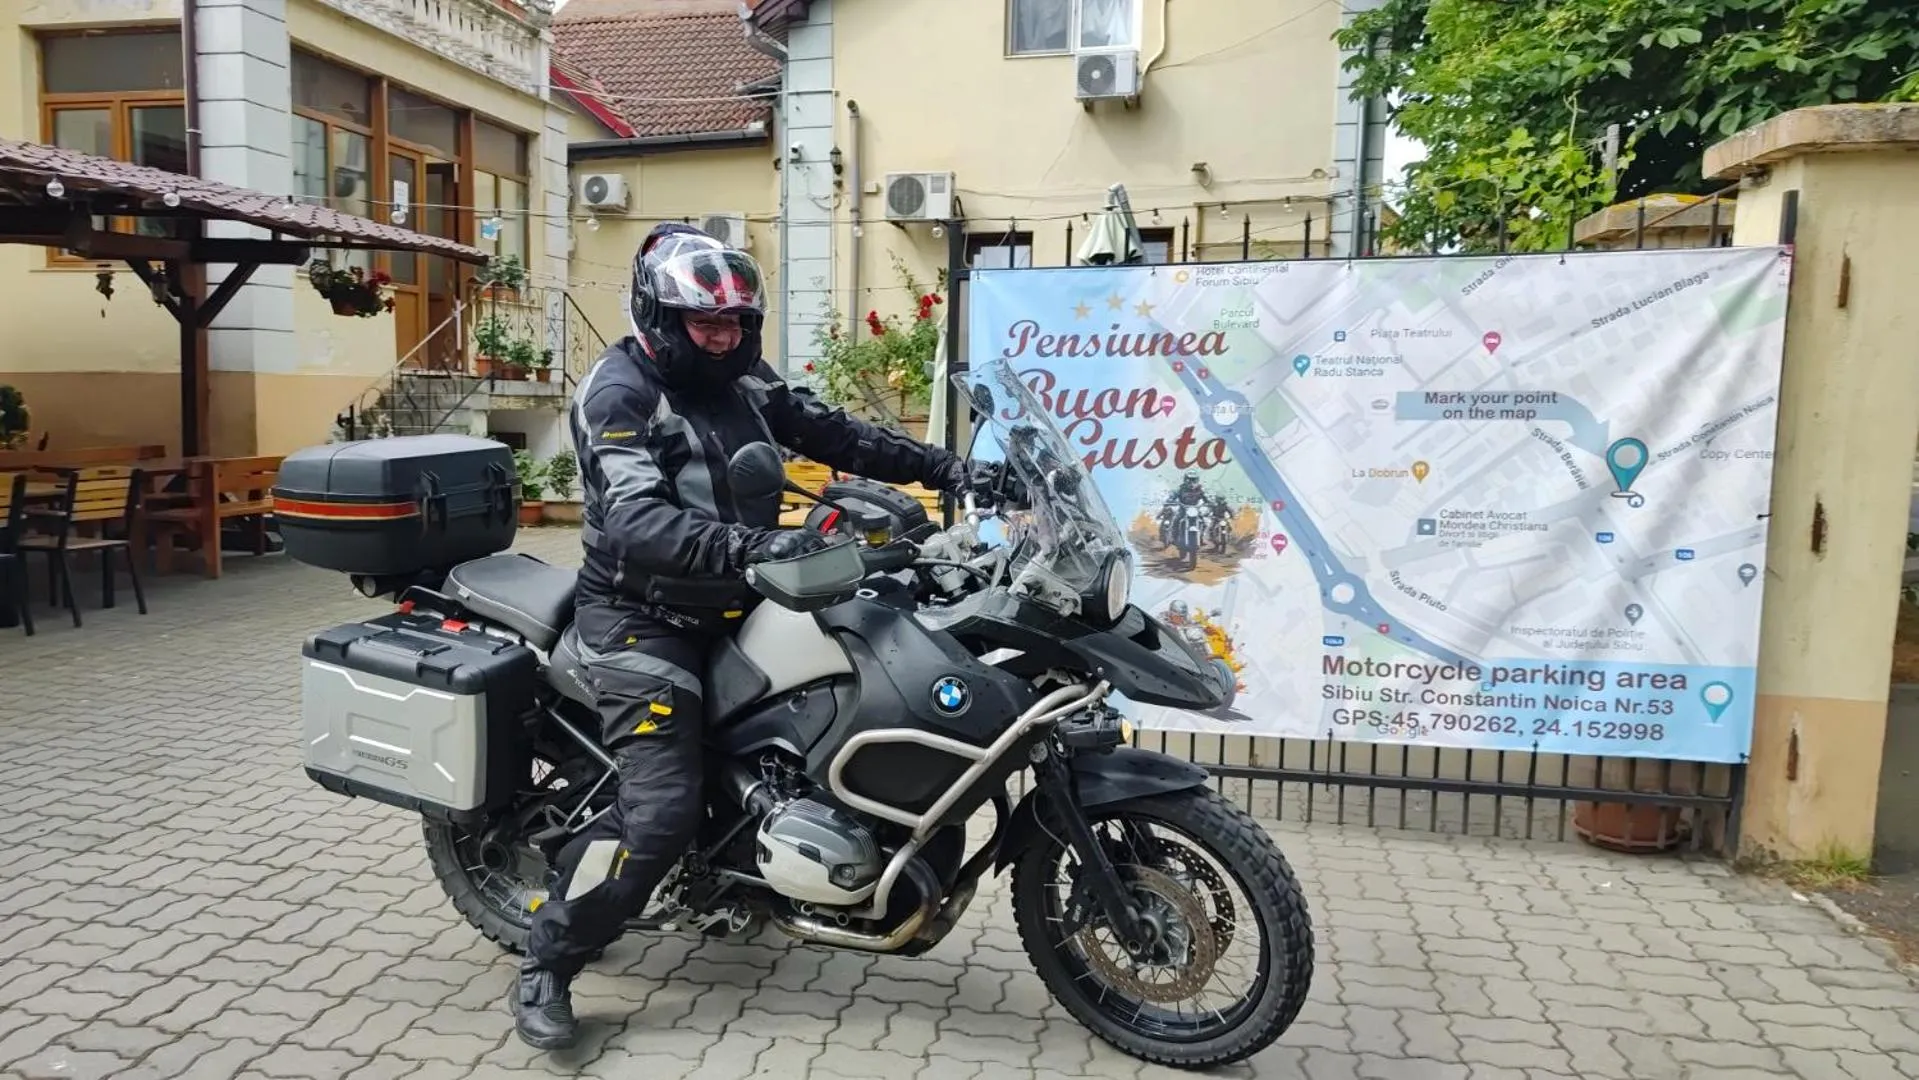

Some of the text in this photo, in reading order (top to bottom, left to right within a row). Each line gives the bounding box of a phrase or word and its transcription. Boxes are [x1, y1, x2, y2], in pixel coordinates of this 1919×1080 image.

[1461, 268, 1495, 296] Strada
[1591, 270, 1711, 329] Strada Lucian Blaga
[1002, 319, 1230, 358] Pensiunea
[1314, 355, 1353, 365] Teatrul
[1314, 367, 1342, 377] Radu
[1424, 391, 1559, 406] Mark your point
[1442, 407, 1537, 421] on the map
[1531, 428, 1564, 453] Strada
[1657, 440, 1691, 461] Strada
[1700, 448, 1774, 461] Copy Cente
[1352, 468, 1366, 478] La
[1440, 509, 1528, 521] Cabinet Avocat
[1390, 570, 1448, 611] Strada Pluto
[1510, 626, 1588, 638] Inspectoratul
[1322, 655, 1687, 692] Motorcycle parking area
[1322, 684, 1674, 715] Sibiu Str. Constantin Noica Nr.53
[1532, 718, 1664, 741] 24.152998
